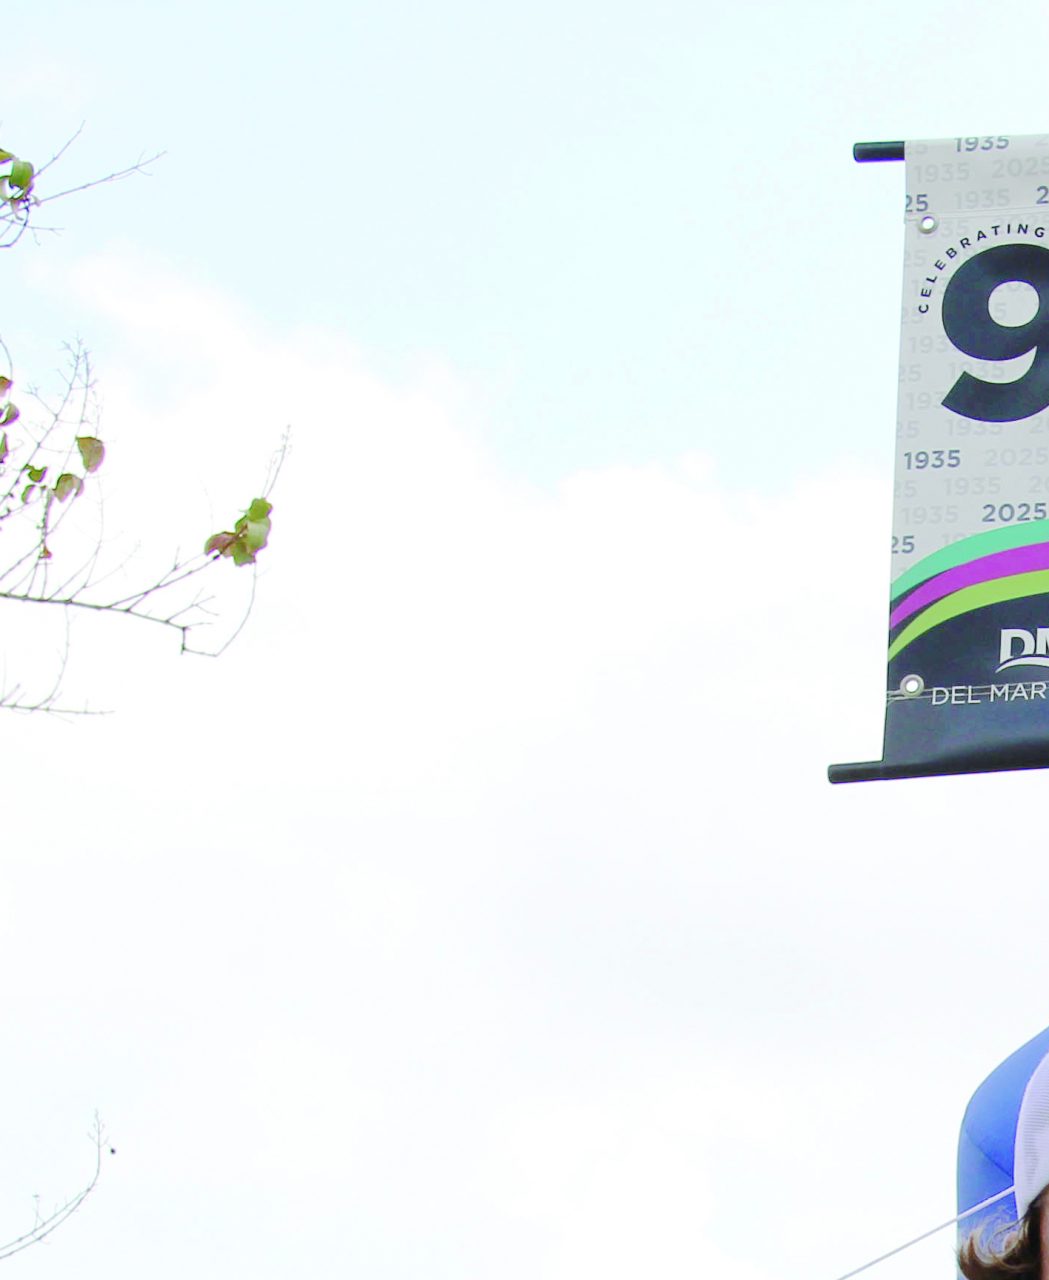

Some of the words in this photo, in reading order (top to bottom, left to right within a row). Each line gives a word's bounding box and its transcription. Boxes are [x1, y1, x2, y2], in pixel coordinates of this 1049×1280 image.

[954, 135, 1010, 153] 1935
[918, 223, 1046, 314] CELEBRATING
[903, 448, 961, 471] 1935
[981, 502, 1048, 523] 2025
[931, 685, 982, 706] DEL
[989, 681, 1048, 703] MAR
